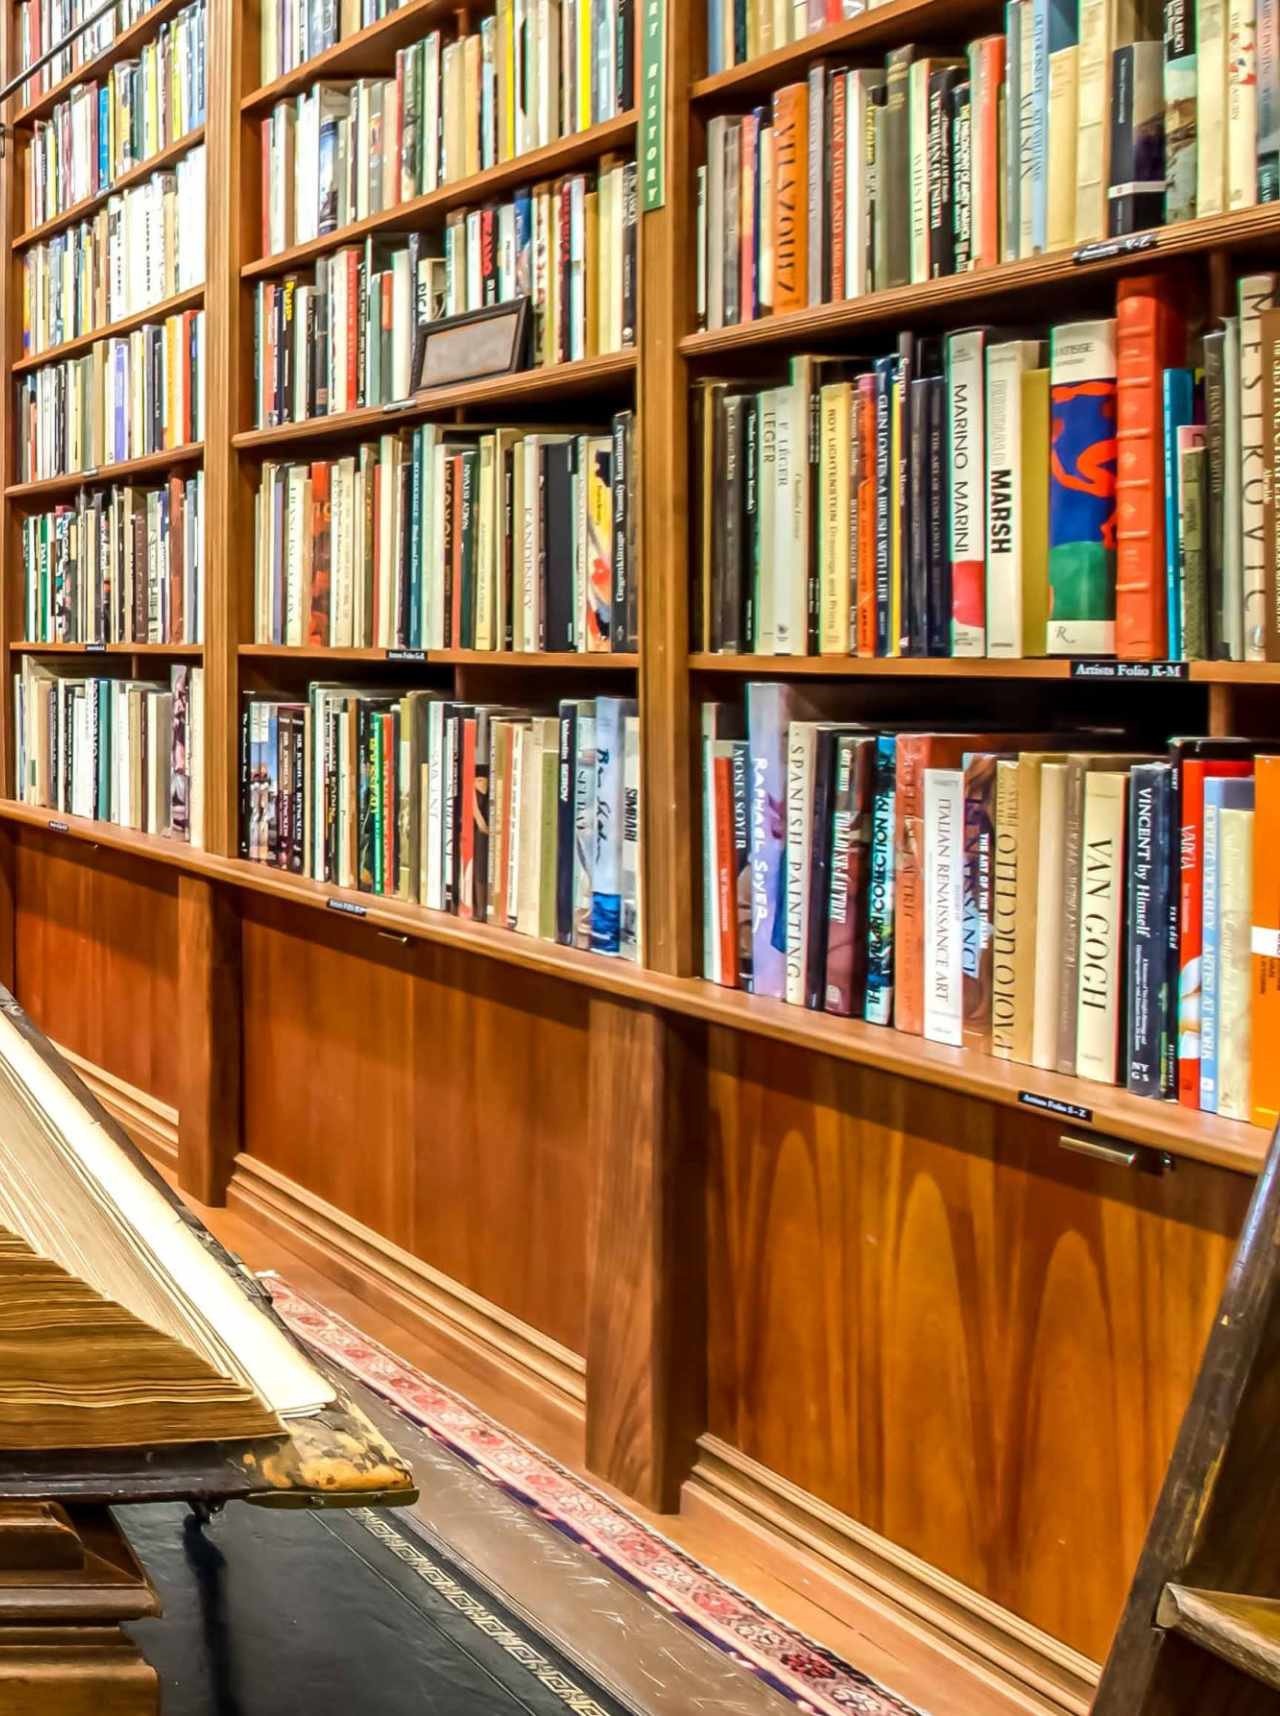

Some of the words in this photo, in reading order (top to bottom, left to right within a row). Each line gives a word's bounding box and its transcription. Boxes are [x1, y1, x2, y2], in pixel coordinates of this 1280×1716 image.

[647, 63, 658, 201] HISTORY
[763, 412, 776, 463] LEGER
[828, 409, 837, 432] ROY
[953, 384, 969, 470] MARINO
[615, 424, 625, 480] Kandinsky
[828, 438, 838, 522] LICHTENSTEIN
[953, 481, 969, 553] MARINI
[991, 469, 1012, 554] MARSH
[524, 507, 533, 609] KANDINSKY
[1075, 664, 1114, 676] Artists
[1117, 664, 1150, 676] Folio
[1152, 665, 1181, 677] K-M
[561, 719, 570, 759] Valentin
[559, 763, 569, 801] SEROV
[789, 745, 805, 845] SPANISH
[624, 787, 638, 842] SIMBARI
[734, 802, 747, 849] SOYER
[936, 798, 951, 858] ITALIAN
[1137, 787, 1152, 861] VINCENT
[978, 833, 990, 853] THE
[978, 855, 989, 873] ART
[1087, 838, 1113, 900] VAN
[978, 876, 989, 890] OF
[1135, 864, 1151, 880] by
[787, 861, 803, 978] PAINTING
[934, 863, 951, 967] RENAISSANCE
[978, 892, 989, 910] THE
[1135, 884, 1151, 938] Himself
[978, 912, 989, 949] ITALIAN
[934, 971, 949, 1002] ART
[1081, 912, 1110, 1013] GOGH
[1203, 943, 1216, 993] ARTIST
[1203, 996, 1215, 1013] AT
[1202, 1017, 1215, 1061] WORK
